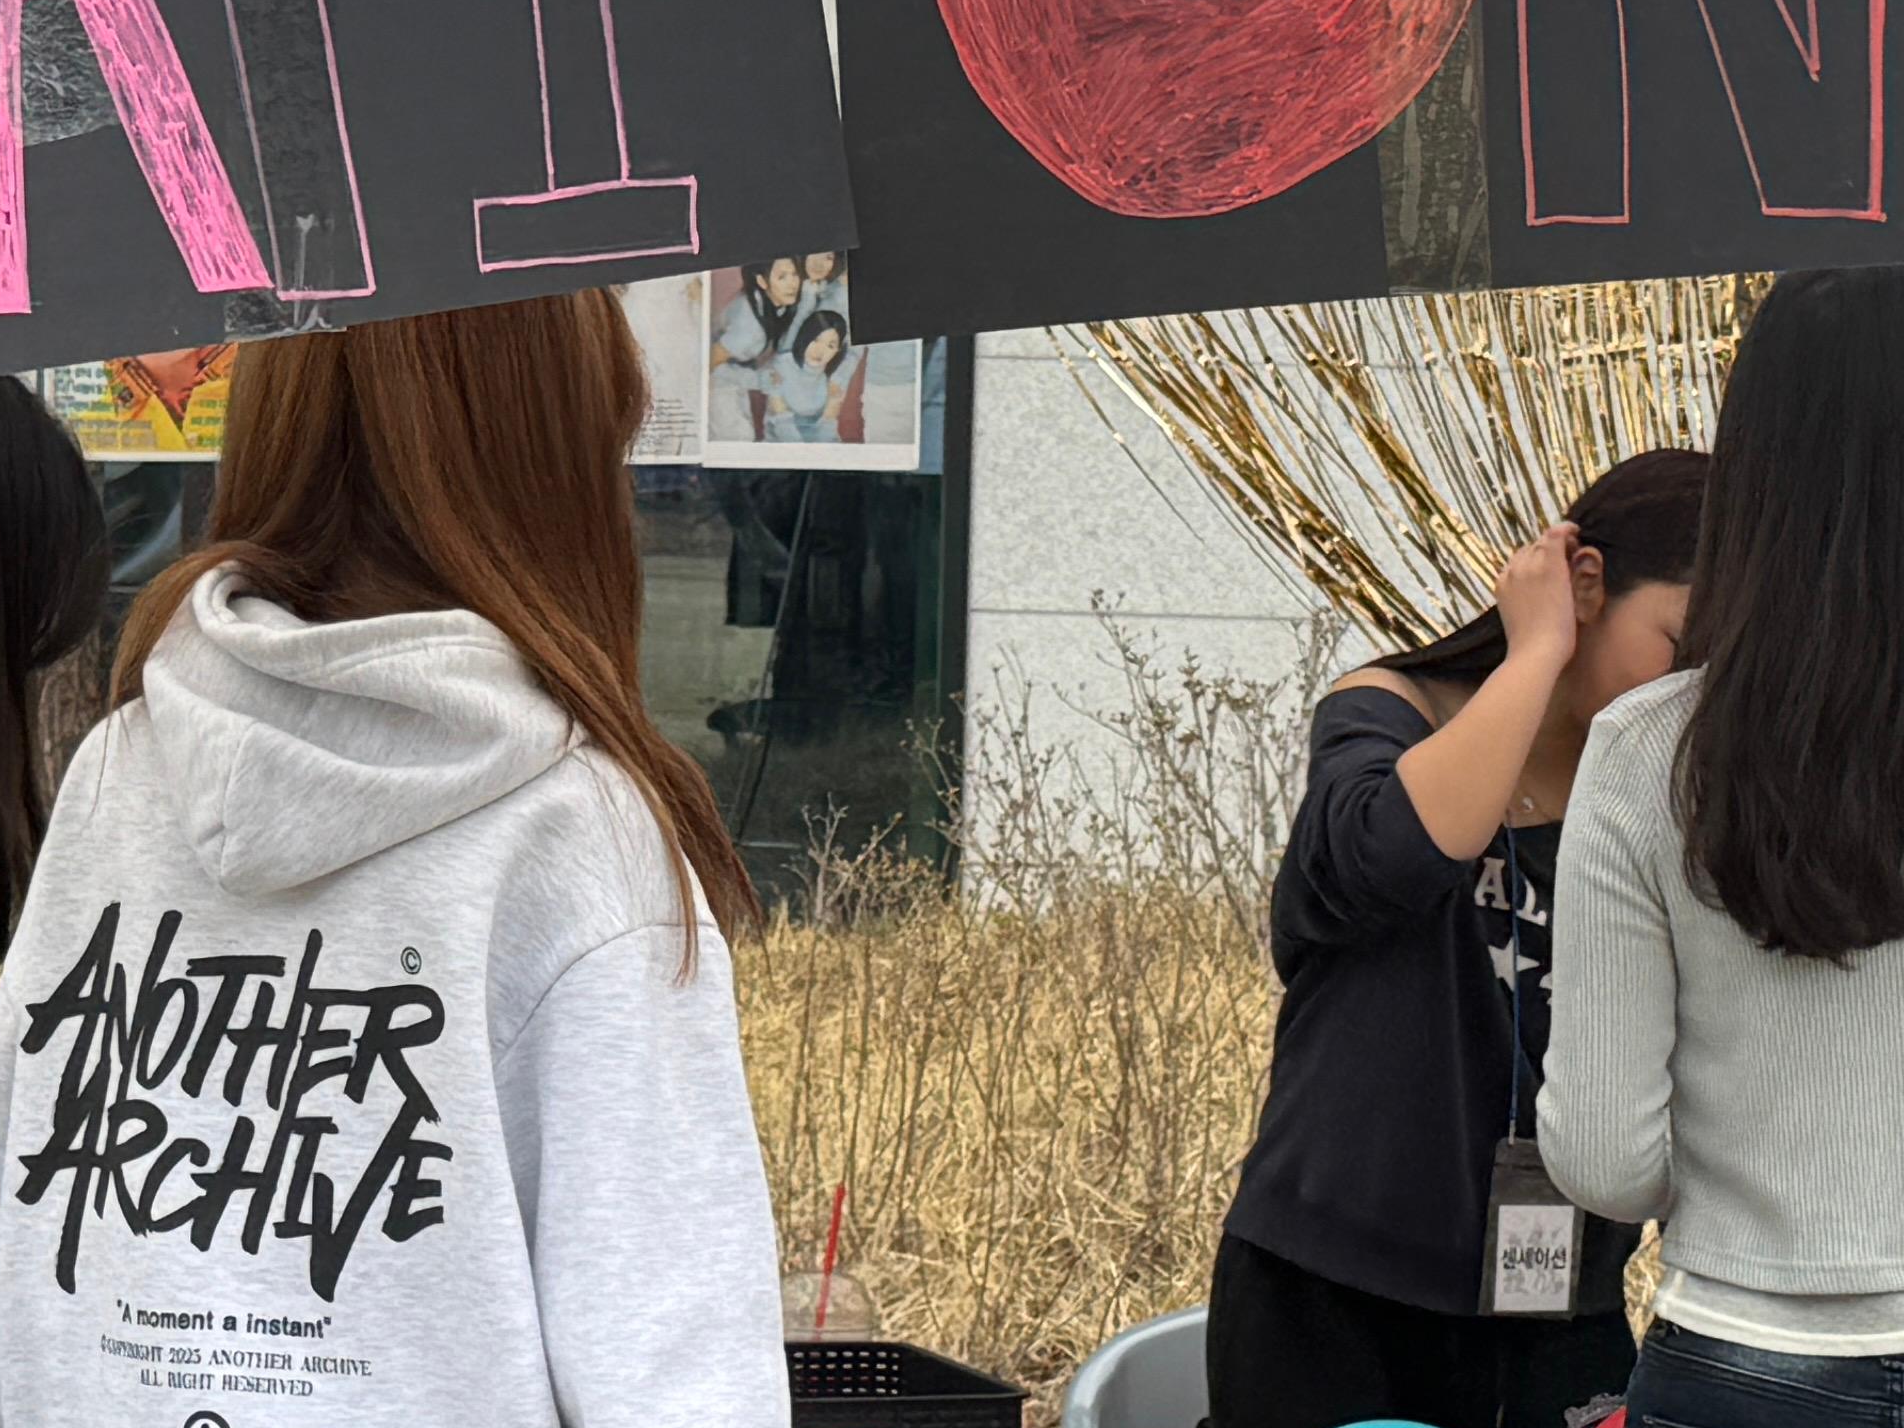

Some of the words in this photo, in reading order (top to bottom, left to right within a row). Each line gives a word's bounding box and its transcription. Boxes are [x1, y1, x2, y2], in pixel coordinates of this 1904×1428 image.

[20, 901, 446, 1125] ANOTHER
[15, 1090, 453, 1302] ARCHIVE
[136, 1309, 214, 1331] moment
[222, 1314, 238, 1332] a
[208, 1349, 293, 1371] ANOTHER
[300, 1355, 373, 1377] ARCHIVE
[167, 1370, 215, 1391] RIGHT
[222, 1373, 314, 1397] RESERVED
